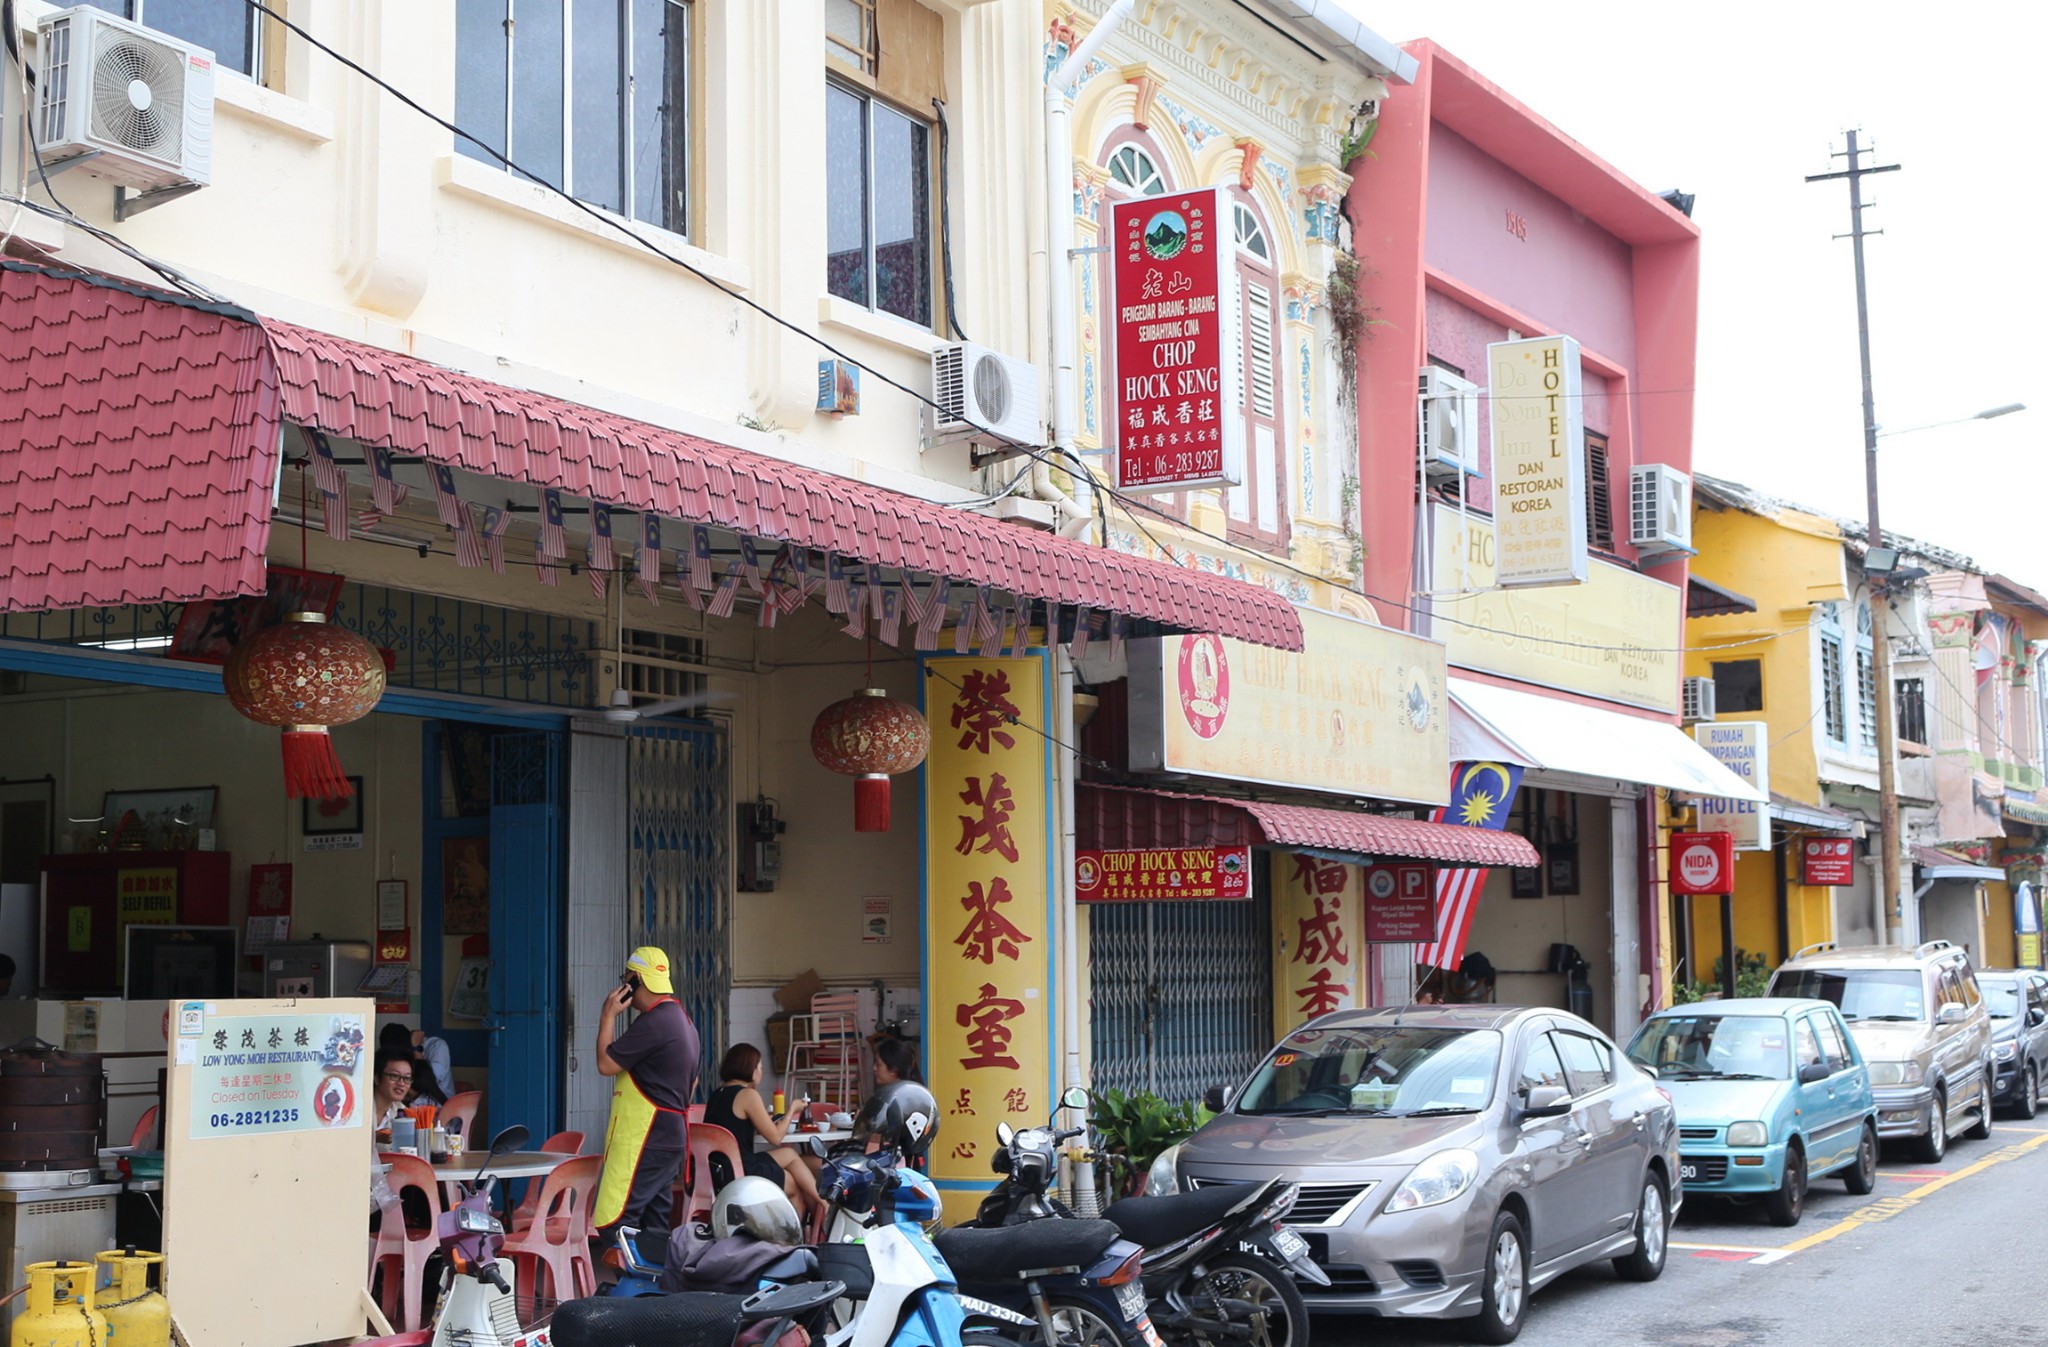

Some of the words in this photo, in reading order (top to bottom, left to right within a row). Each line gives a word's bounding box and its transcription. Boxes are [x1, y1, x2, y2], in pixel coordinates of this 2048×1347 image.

[1122, 303, 1156, 323] PENGEDAR
[1158, 299, 1184, 319] BARANG
[1189, 295, 1216, 315] BARANG
[1138, 321, 1182, 343] SEMBAHYANG
[1184, 319, 1200, 336] CINA
[1153, 340, 1196, 369] CHOP
[1125, 372, 1171, 402] HOCK
[1177, 366, 1219, 396] SENG
[1497, 361, 1527, 389] Da
[1498, 395, 1542, 424] Som
[1542, 348, 1561, 458] HOTEL
[1500, 430, 1531, 457] Inn
[1195, 449, 1219, 471] 9287
[1518, 461, 1543, 476] DAN
[1500, 478, 1563, 496] RESTORAN
[1511, 498, 1552, 514] KOREA
[1621, 642, 1665, 664] RESTORAN
[1620, 663, 1649, 681] KOREA
[1711, 729, 1743, 743] RUMAH
[1702, 797, 1756, 814] HOTEL
[1823, 844, 1832, 854] P
[951, 668, 1032, 1072] 榮茂茶室
[1101, 853, 1136, 872] CHOP
[1140, 852, 1177, 871] HOCK
[1182, 850, 1215, 870] SENG
[1685, 855, 1713, 868] NIDA
[1406, 871, 1422, 895] P
[122, 896, 141, 911] SELF
[144, 895, 171, 910] REFILL
[467, 966, 489, 989] 31
[202, 1054, 221, 1067] LOW
[223, 1053, 246, 1066] YONG
[246, 1052, 267, 1065] MOH
[267, 1050, 318, 1064] RESTAURANT
[219, 1073, 293, 1089] 每逢星期二休息
[211, 1091, 246, 1104] Closed
[247, 1092, 260, 1102] on
[261, 1088, 299, 1103] Tuesday
[210, 1108, 299, 1128] 06-2821235
[960, 1296, 989, 1313] MAU
[989, 1304, 1026, 1325] 3317
